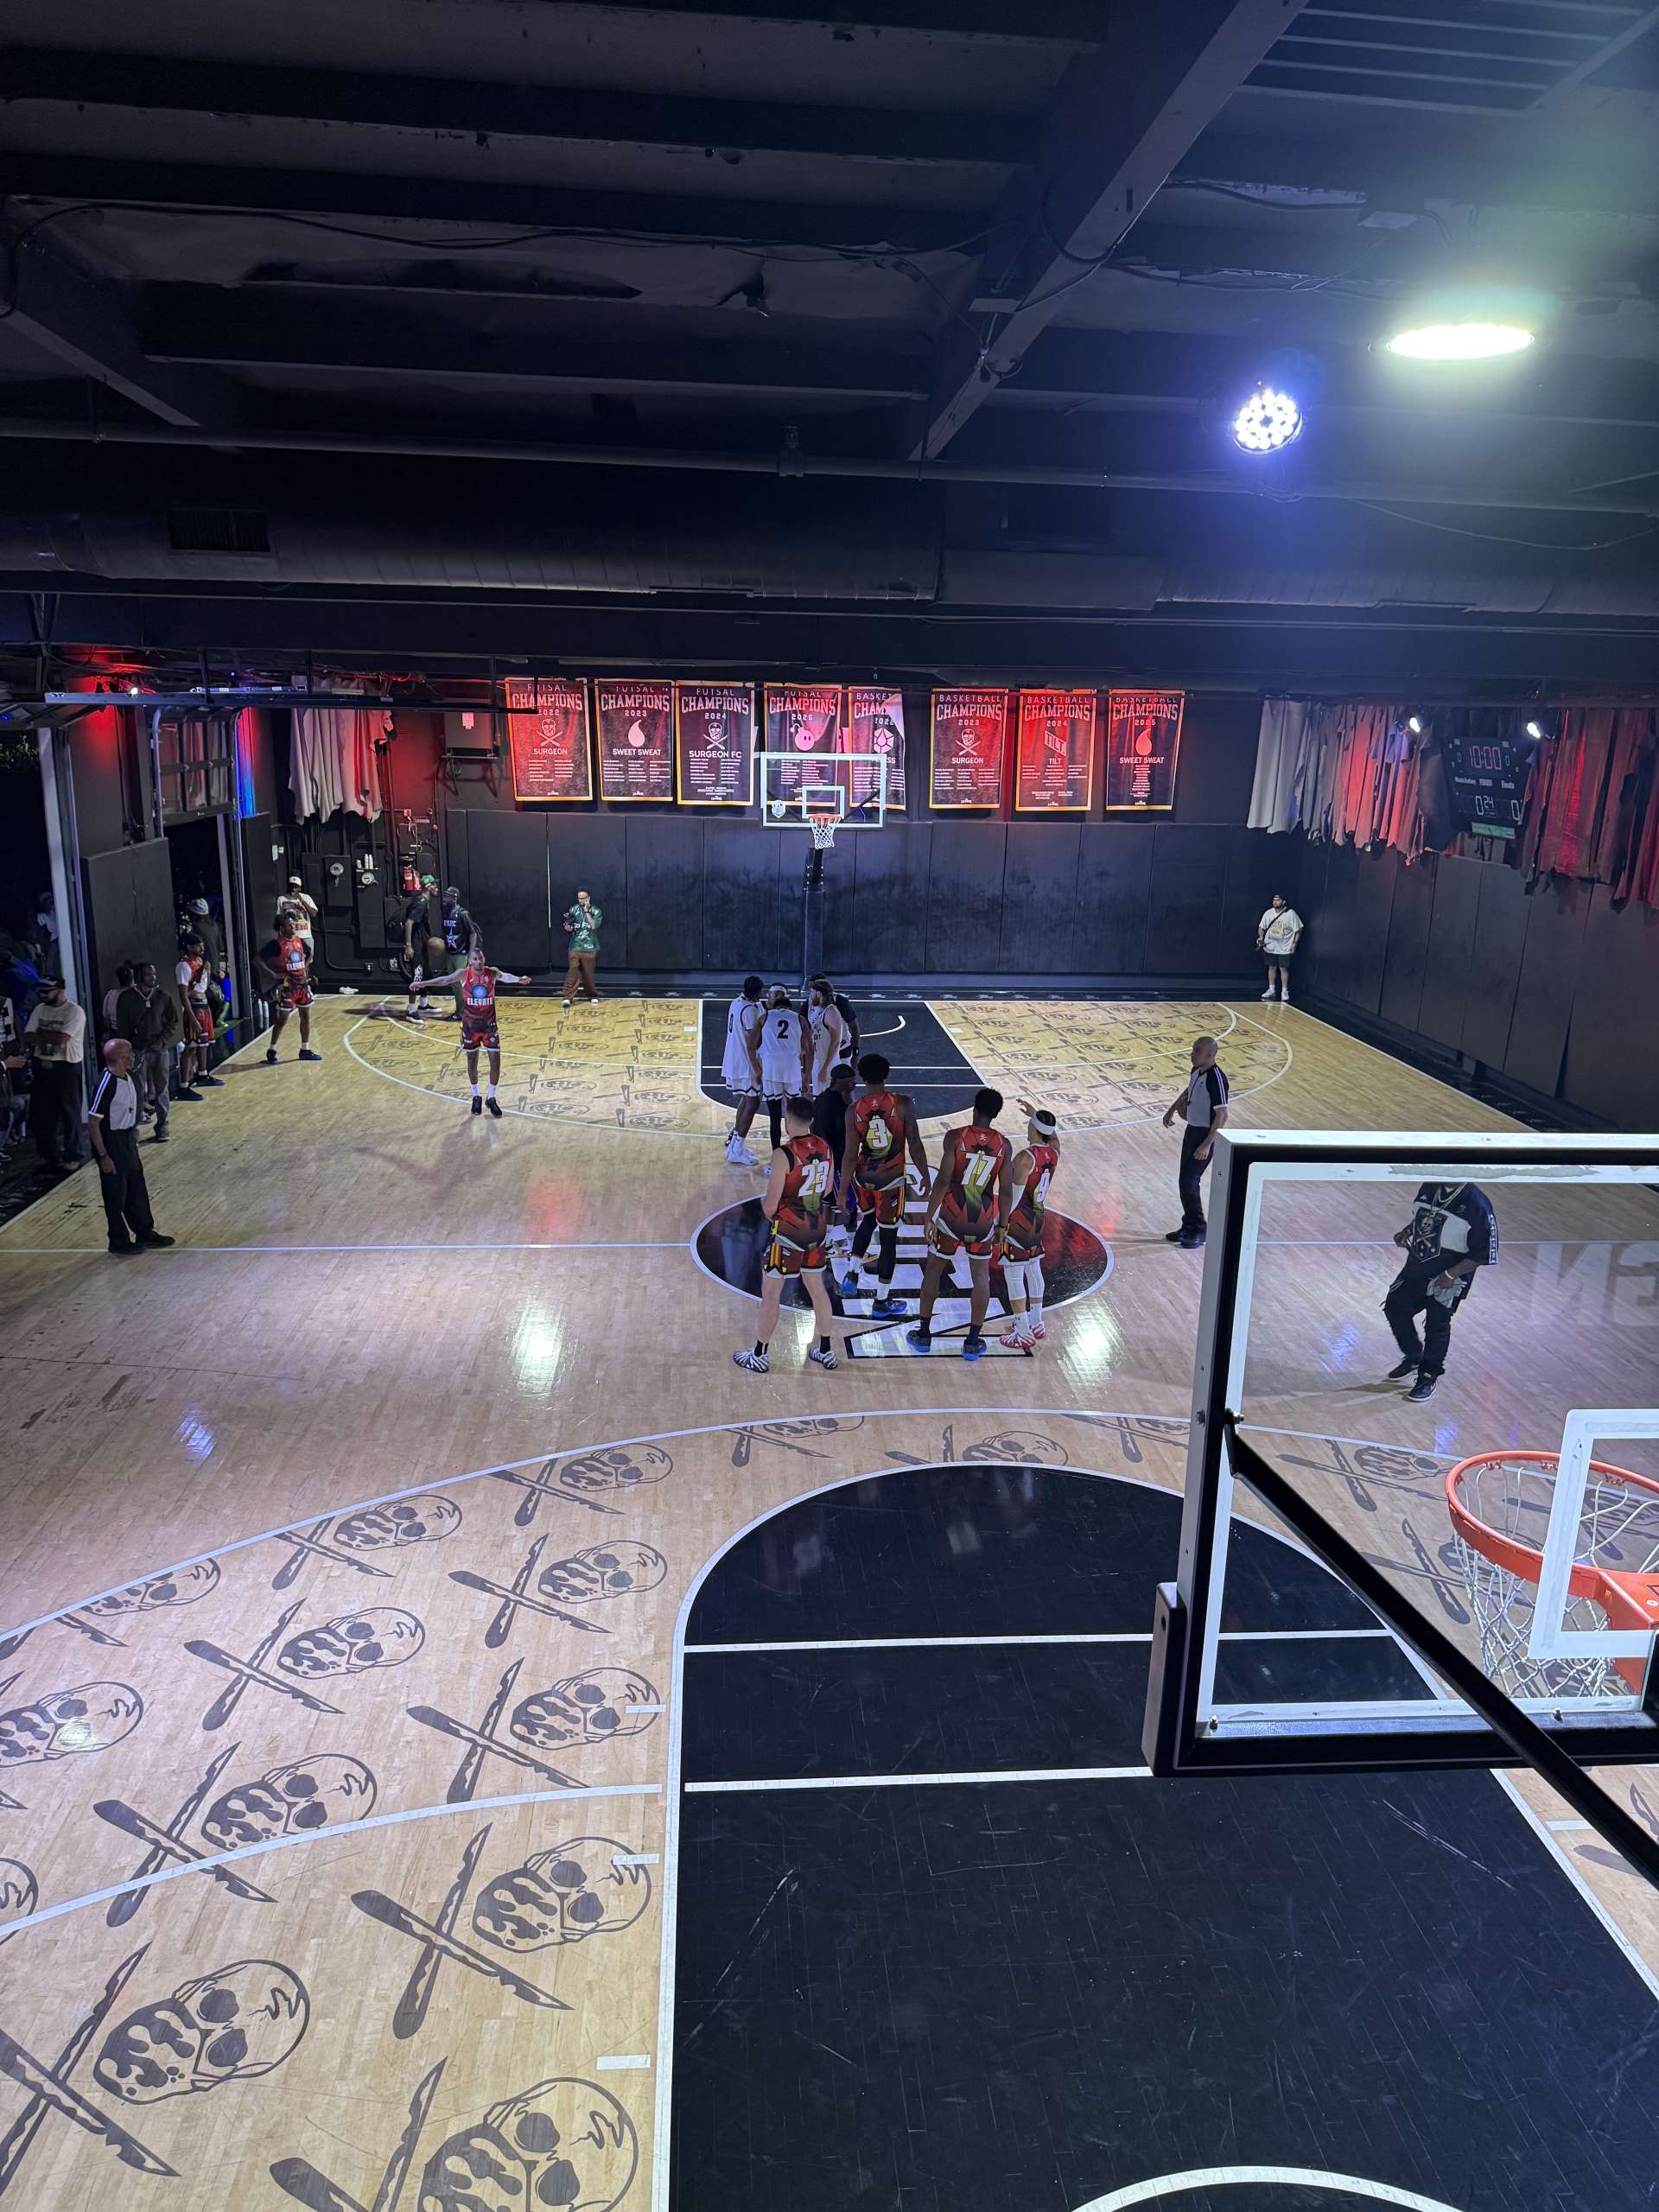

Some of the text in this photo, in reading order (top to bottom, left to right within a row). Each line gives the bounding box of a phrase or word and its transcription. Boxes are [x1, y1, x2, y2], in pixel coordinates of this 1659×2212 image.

[512, 693, 583, 710] CHAMPIONS
[601, 694, 671, 712] CHAMPIONS
[681, 696, 749, 715] CHAMPIONS
[769, 696, 836, 715] CHAMPIONS
[939, 694, 1001, 702] BASKETBALL
[936, 703, 1002, 721] CHAMPIONS
[1024, 704, 1090, 721] CHAMPIONS
[1112, 703, 1179, 721] CHAMPIONS
[1470, 746, 1502, 770] 10:00
[1484, 795, 1495, 809] 24
[467, 997, 493, 1006] ELEVATE
[777, 1020, 789, 1039] 2
[868, 1119, 888, 1148] 3
[798, 1160, 830, 1197] 23
